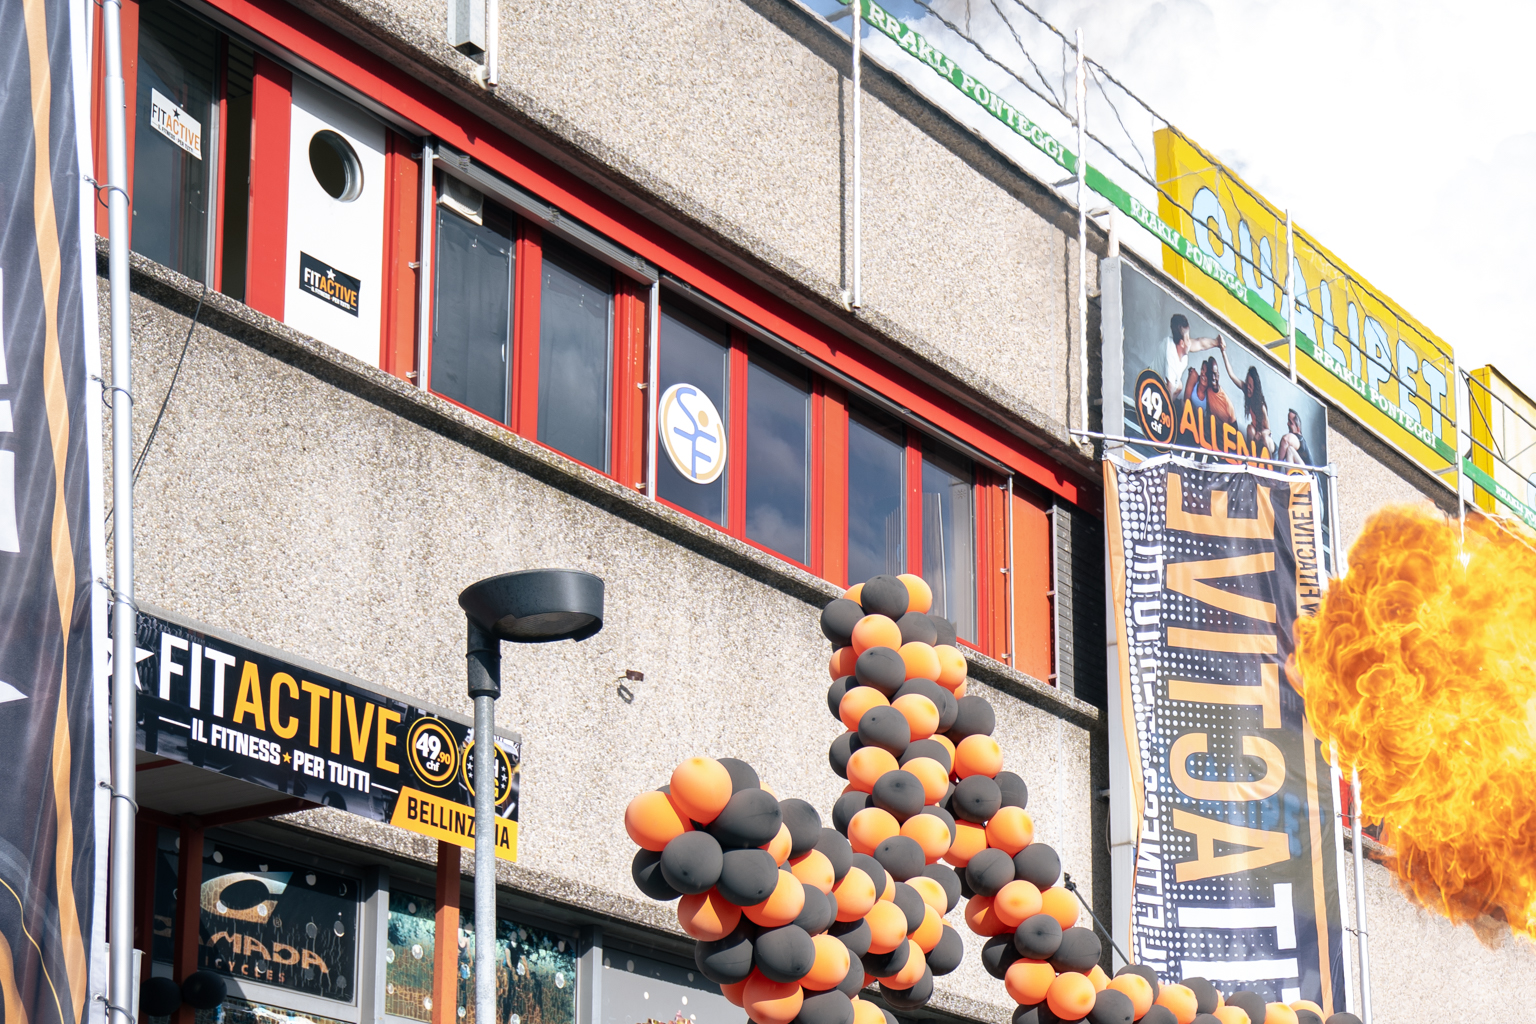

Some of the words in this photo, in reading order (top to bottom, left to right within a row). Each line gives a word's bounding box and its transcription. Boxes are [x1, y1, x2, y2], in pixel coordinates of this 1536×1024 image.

[152, 102, 201, 152] FITACTIVE
[961, 73, 1066, 166] PONTEGGI
[304, 267, 358, 307] FITACTIVE
[1186, 240, 1249, 303] PONTEGGI
[1191, 185, 1449, 440] QUALIPET
[1370, 390, 1437, 450] PONTEGGI
[159, 631, 402, 775] FITACTIVE
[191, 717, 207, 744] IL
[211, 724, 281, 766] FITNESS
[293, 749, 325, 780] PER
[327, 760, 371, 793] TUTTI
[426, 759, 440, 773] chf
